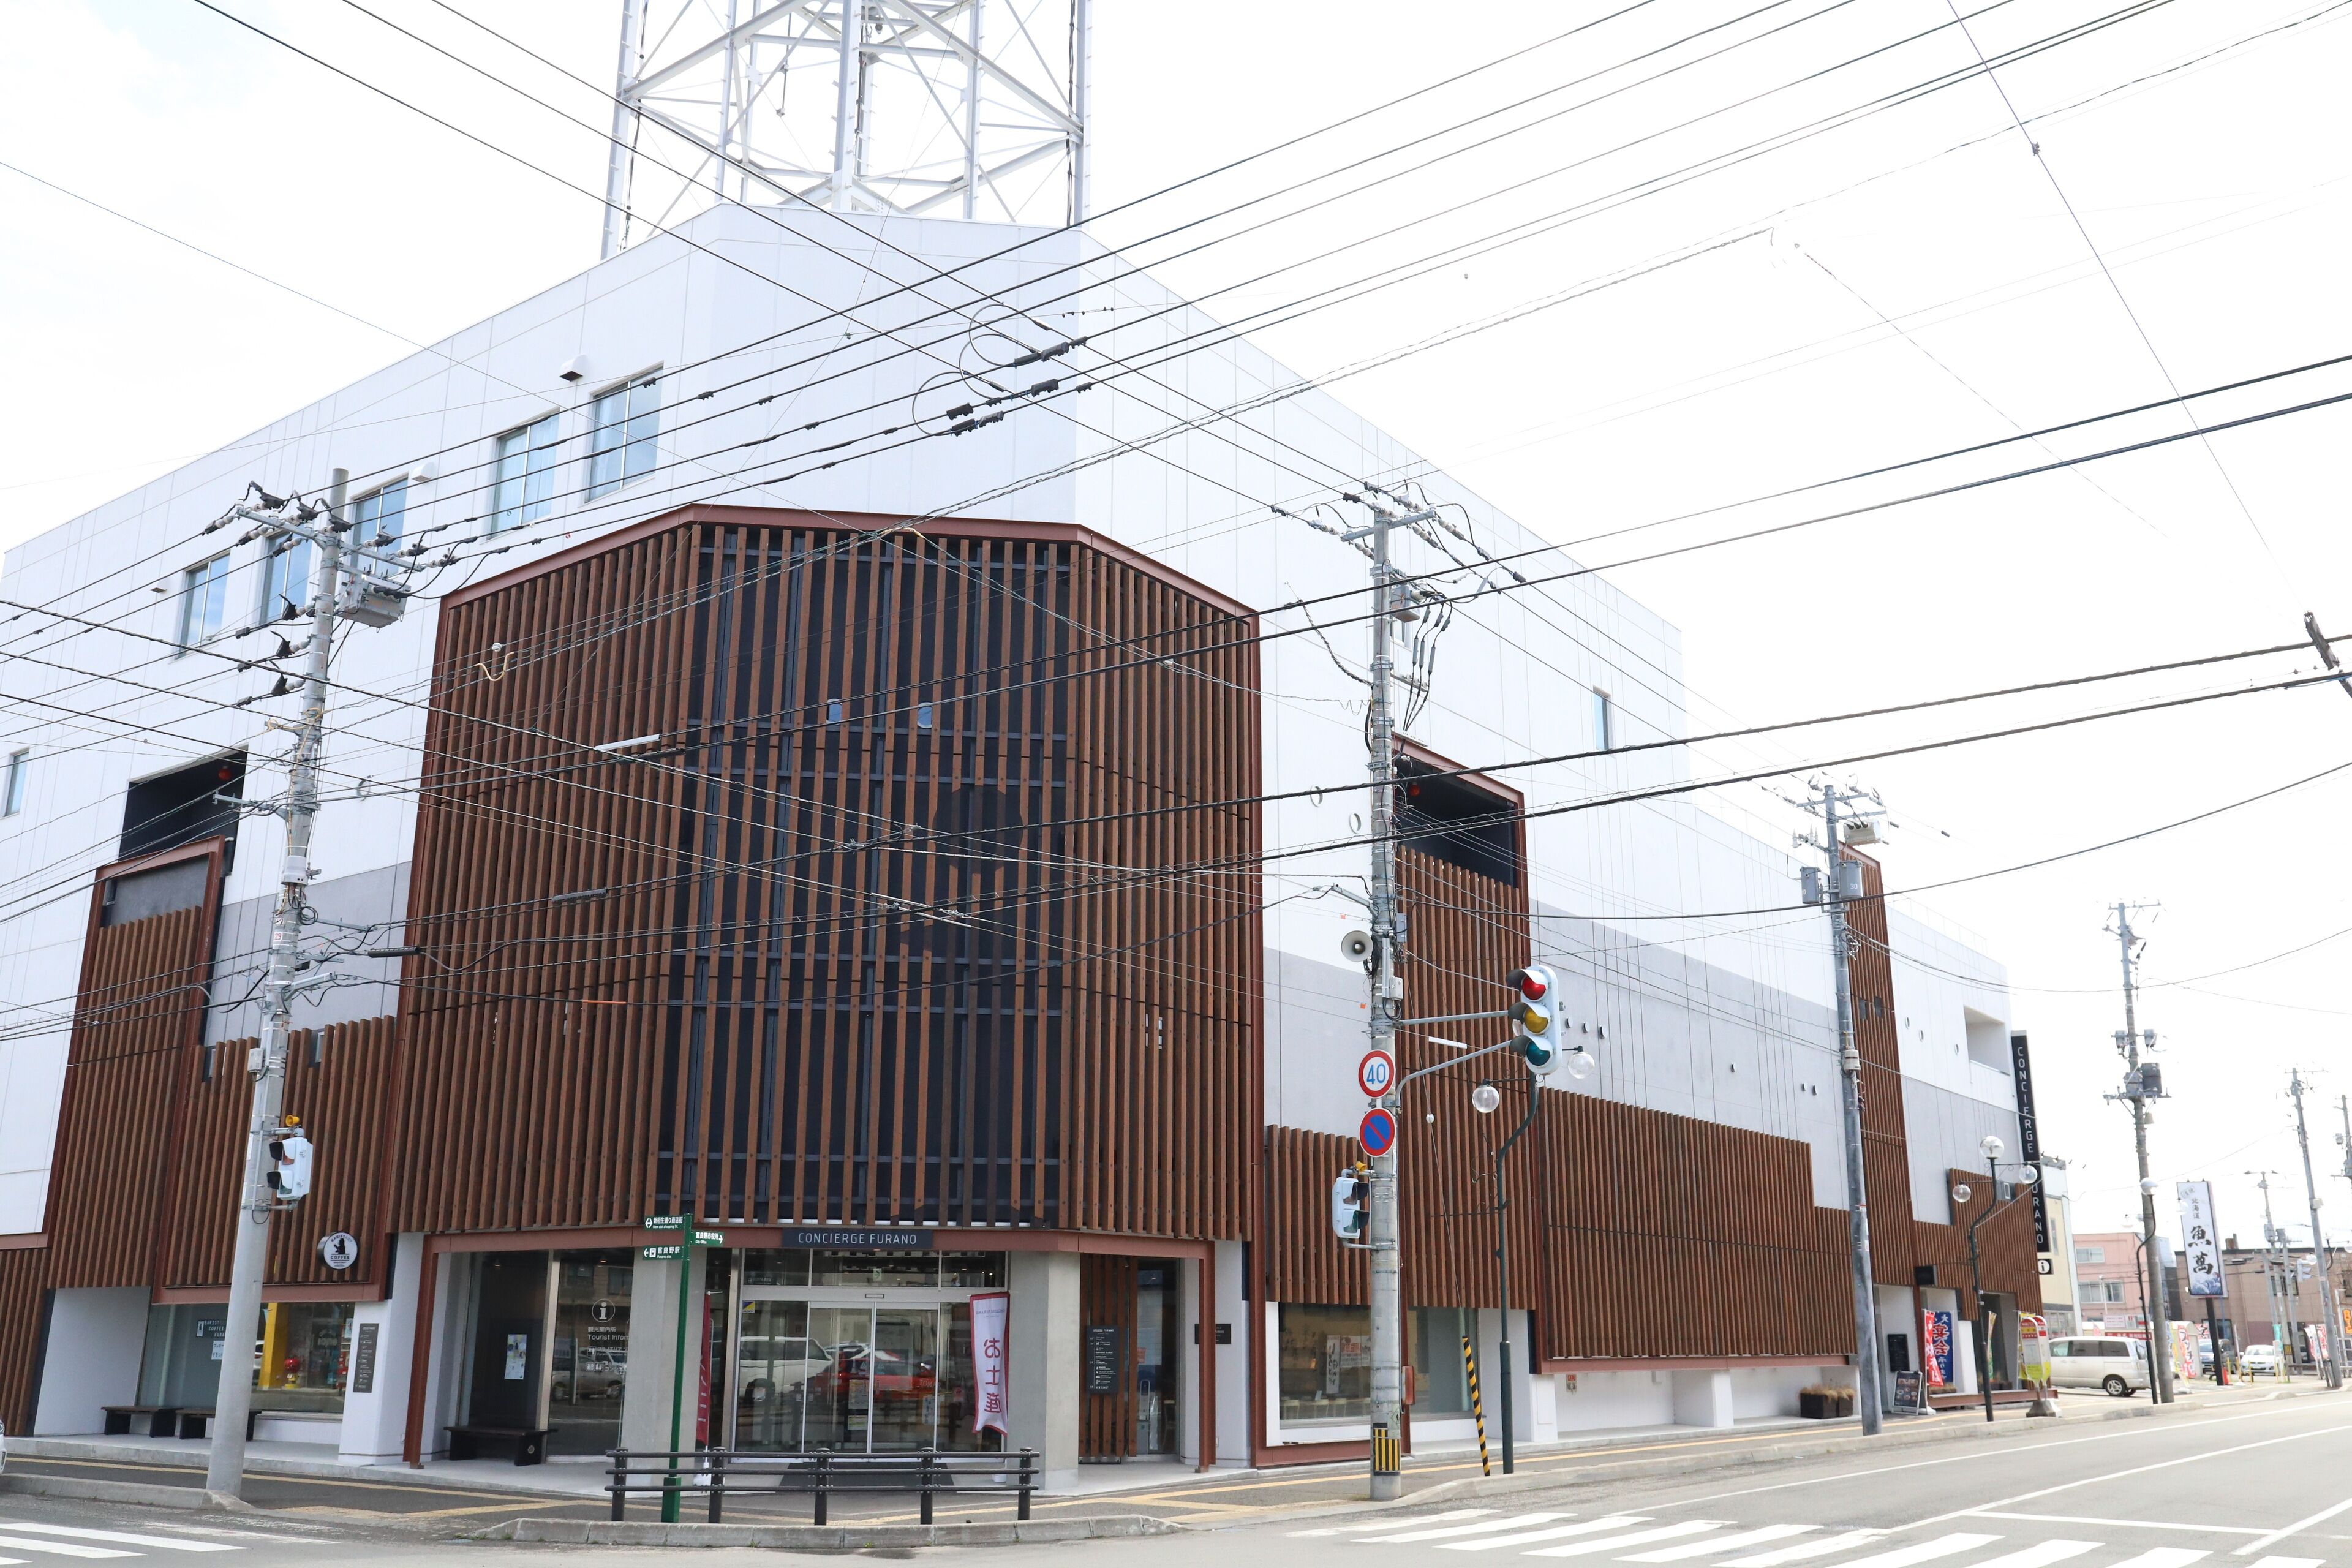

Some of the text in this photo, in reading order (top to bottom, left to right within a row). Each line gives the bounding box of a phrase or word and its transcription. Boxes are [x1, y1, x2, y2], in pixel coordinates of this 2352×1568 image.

[1366, 1063, 1386, 1085] 40
[2018, 1047, 2034, 1153] CONCIERGE
[2031, 1184, 2044, 1243] URANO
[2192, 1197, 2201, 1219] 北海道
[695, 1231, 719, 1240] 富良野市役所
[798, 1232, 917, 1245] CONCIERGE FURANO
[2187, 1224, 2214, 1275] 魚萬
[1932, 1323, 1950, 1356] 宴会
